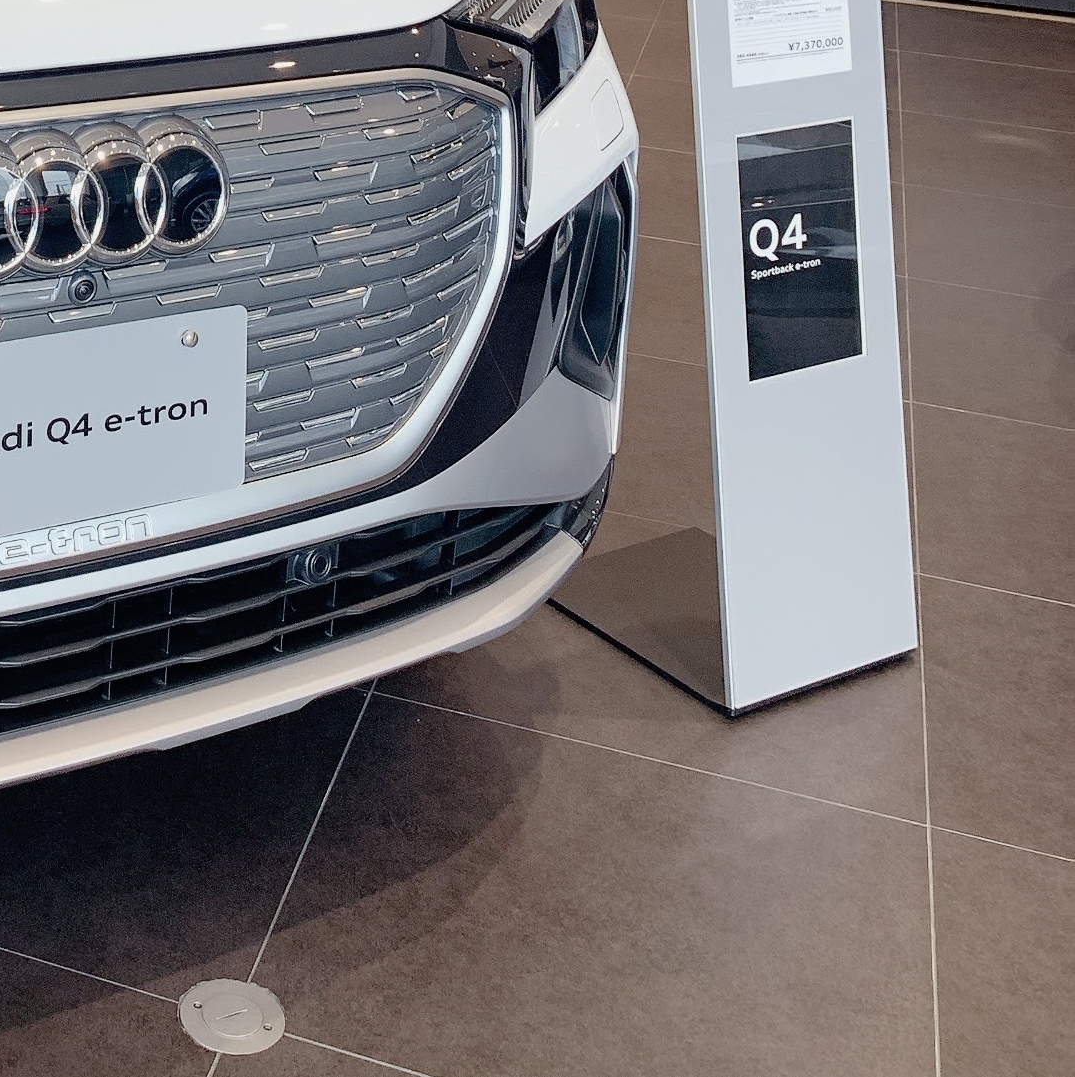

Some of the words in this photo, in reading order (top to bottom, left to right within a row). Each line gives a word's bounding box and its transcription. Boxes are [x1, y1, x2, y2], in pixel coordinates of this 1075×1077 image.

[788, 37, 844, 51] ¥7,370,000
[748, 212, 808, 262] Q4
[750, 263, 794, 281] Sportback
[795, 258, 821, 271] e-tron
[46, 412, 93, 445] Q4
[104, 397, 209, 433] e-tron
